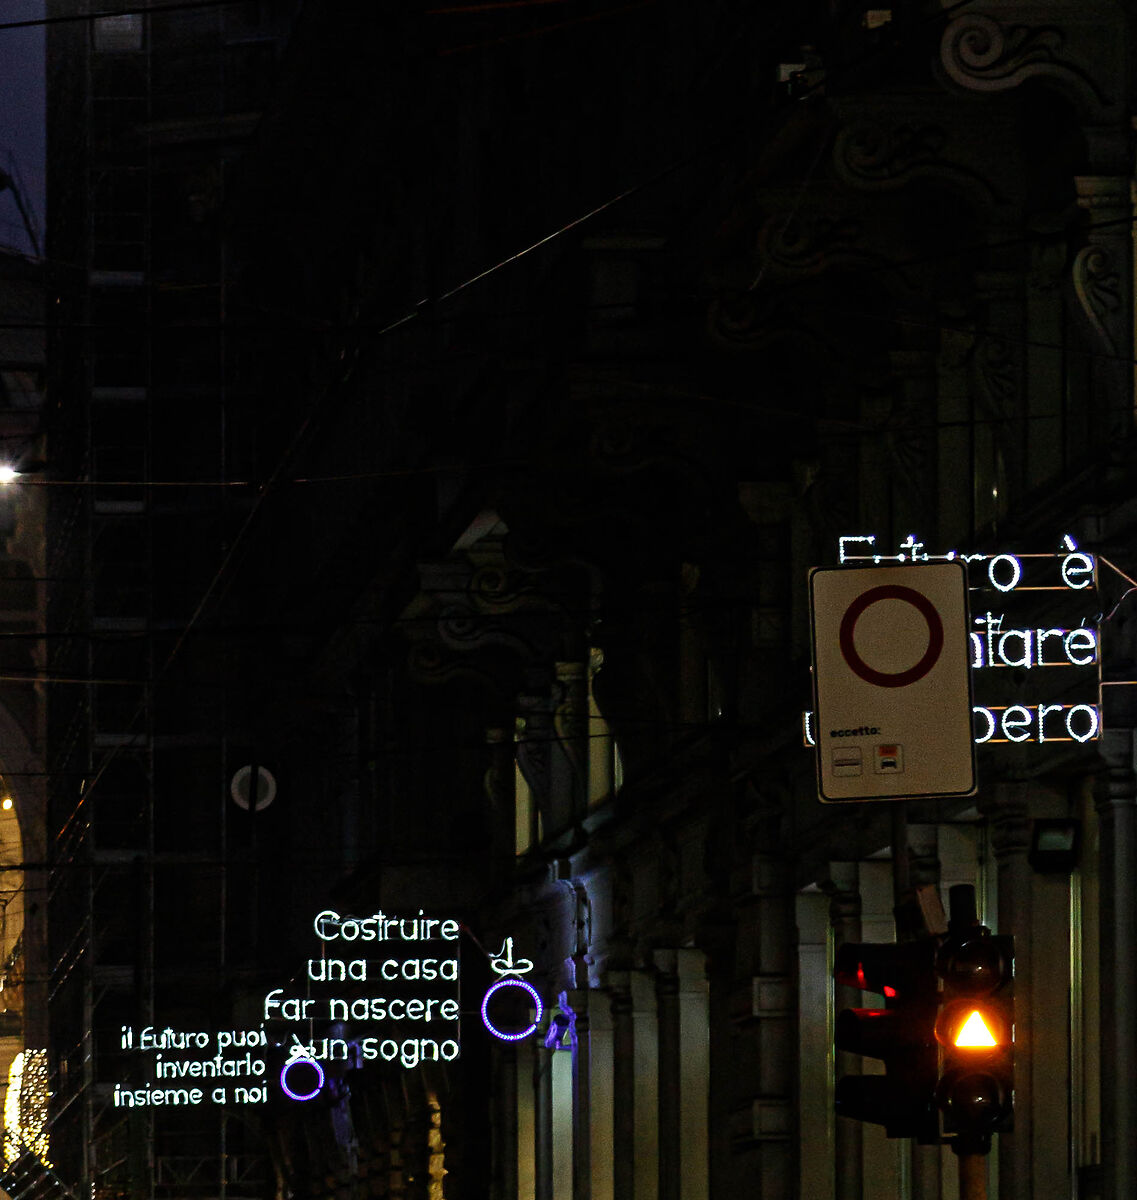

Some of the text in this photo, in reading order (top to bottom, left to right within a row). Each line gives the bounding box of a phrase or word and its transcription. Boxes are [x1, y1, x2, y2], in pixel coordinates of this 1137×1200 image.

[1060, 534, 1095, 590] è
[314, 910, 459, 941] Costruire
[308, 959, 457, 981] una casa
[330, 998, 459, 1022] nascere
[217, 1022, 267, 1054] puoi
[156, 1052, 266, 1078] inventarlo
[310, 1038, 459, 1068] un sogno
[114, 1080, 268, 1107] insieme a noi
